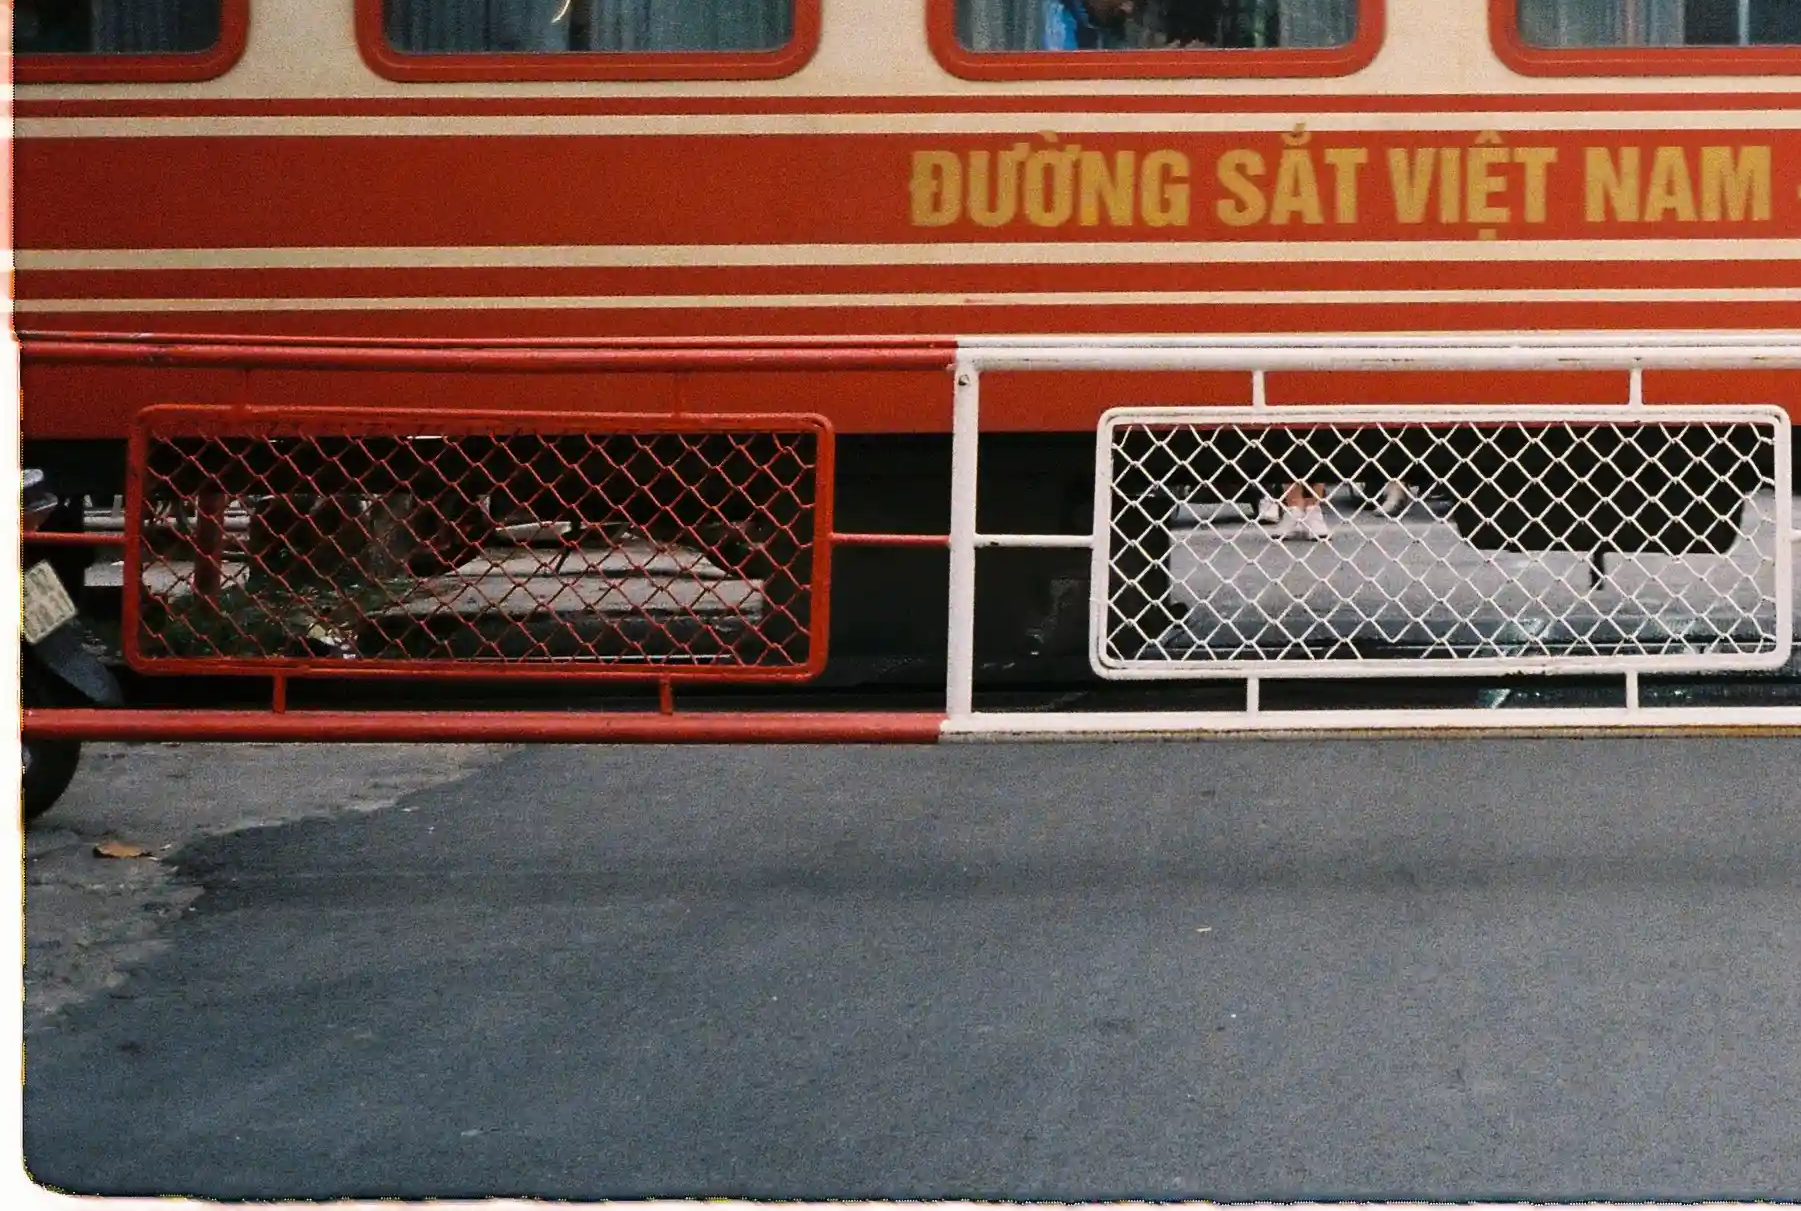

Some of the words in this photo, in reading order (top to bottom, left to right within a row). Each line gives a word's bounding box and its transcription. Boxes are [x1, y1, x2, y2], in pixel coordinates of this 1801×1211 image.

[910, 131, 1191, 228] ĐƯỜNG
[1216, 122, 1367, 226] SẮT
[1387, 129, 1559, 241] VIỆT
[1586, 145, 1774, 222] NAM
